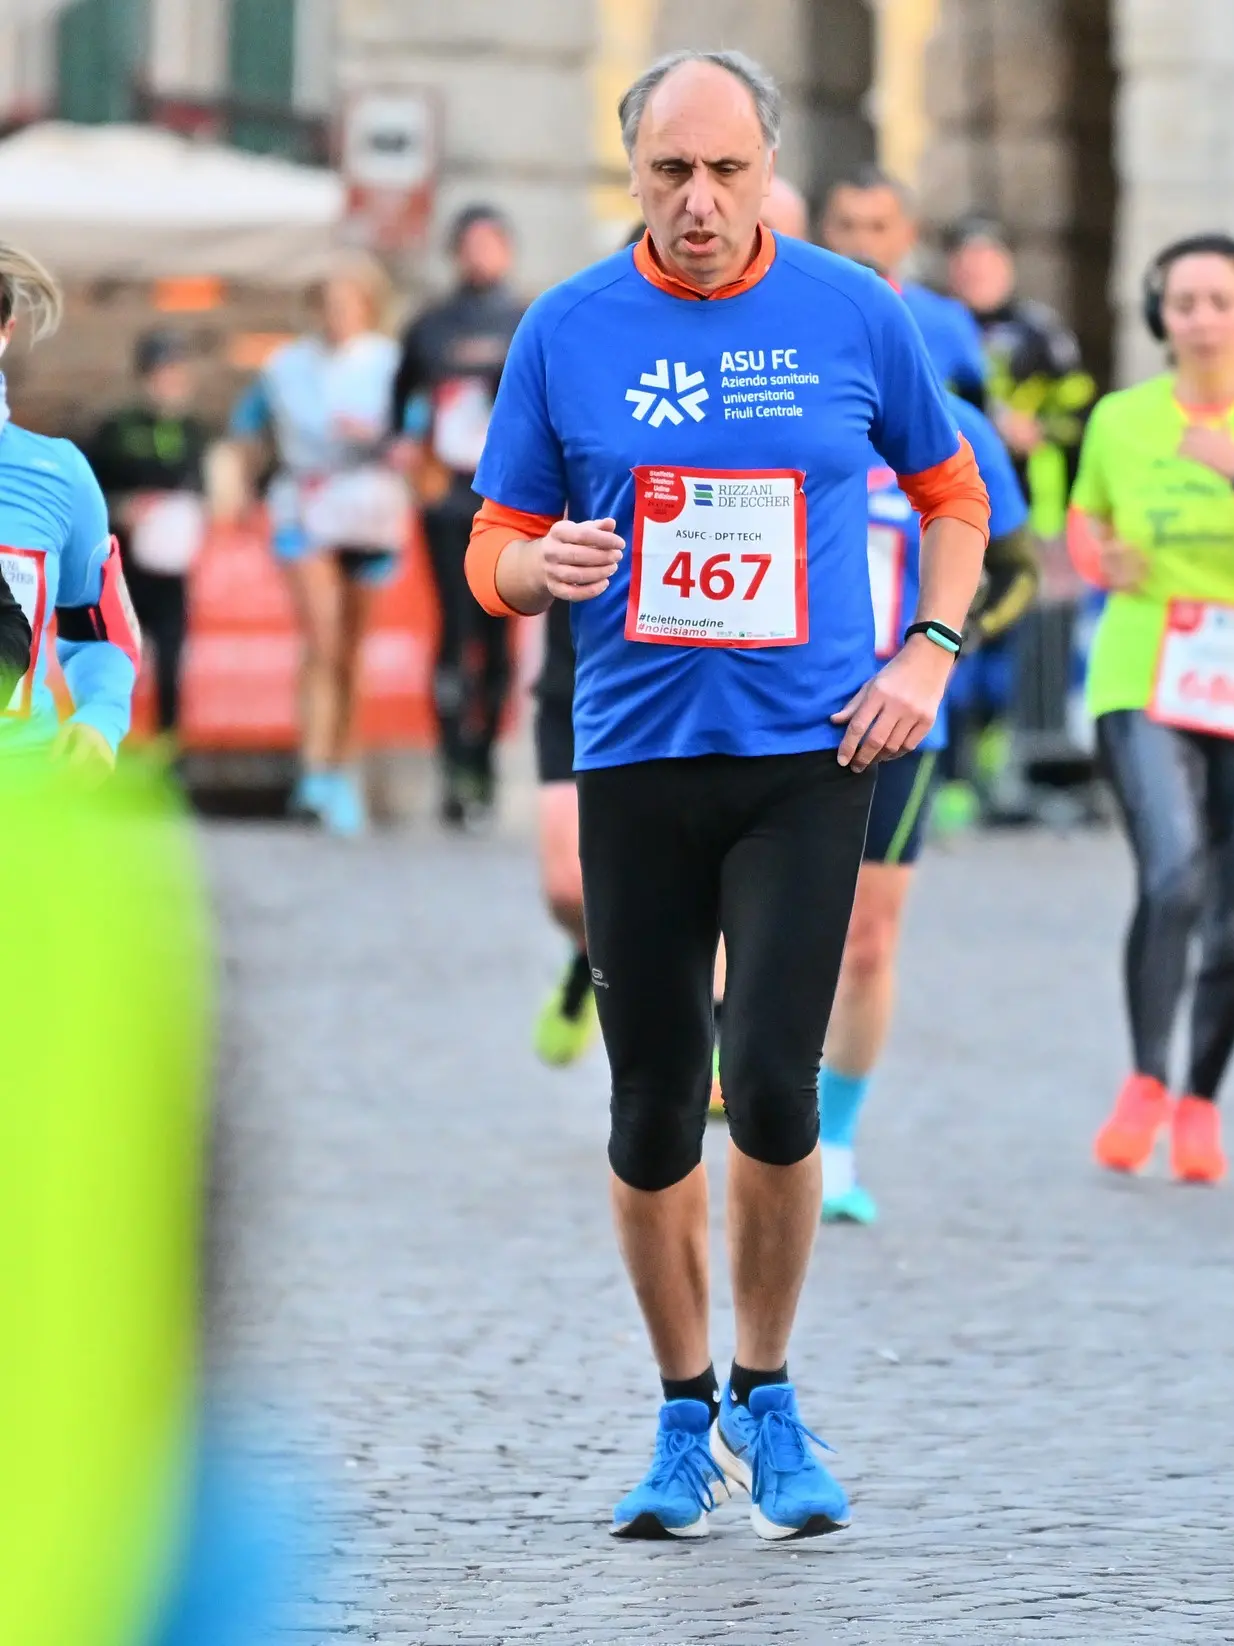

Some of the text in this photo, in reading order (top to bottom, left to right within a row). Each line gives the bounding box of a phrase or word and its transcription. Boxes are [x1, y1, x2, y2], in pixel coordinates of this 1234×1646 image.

[720, 348, 799, 373] ASU FC
[721, 372, 820, 388] Azienda sanitaria
[722, 389, 795, 404] universitaria
[724, 405, 803, 420] Friuli Centrale
[718, 484, 773, 496] RIZZANI
[718, 495, 791, 508] DE ECCHER
[675, 529, 707, 541] ASUFC
[714, 532, 735, 541] DPT
[737, 532, 762, 542] TECH
[662, 551, 773, 601] 467
[638, 613, 725, 629] #telethonudine
[637, 622, 708, 638] #noicisiamo
